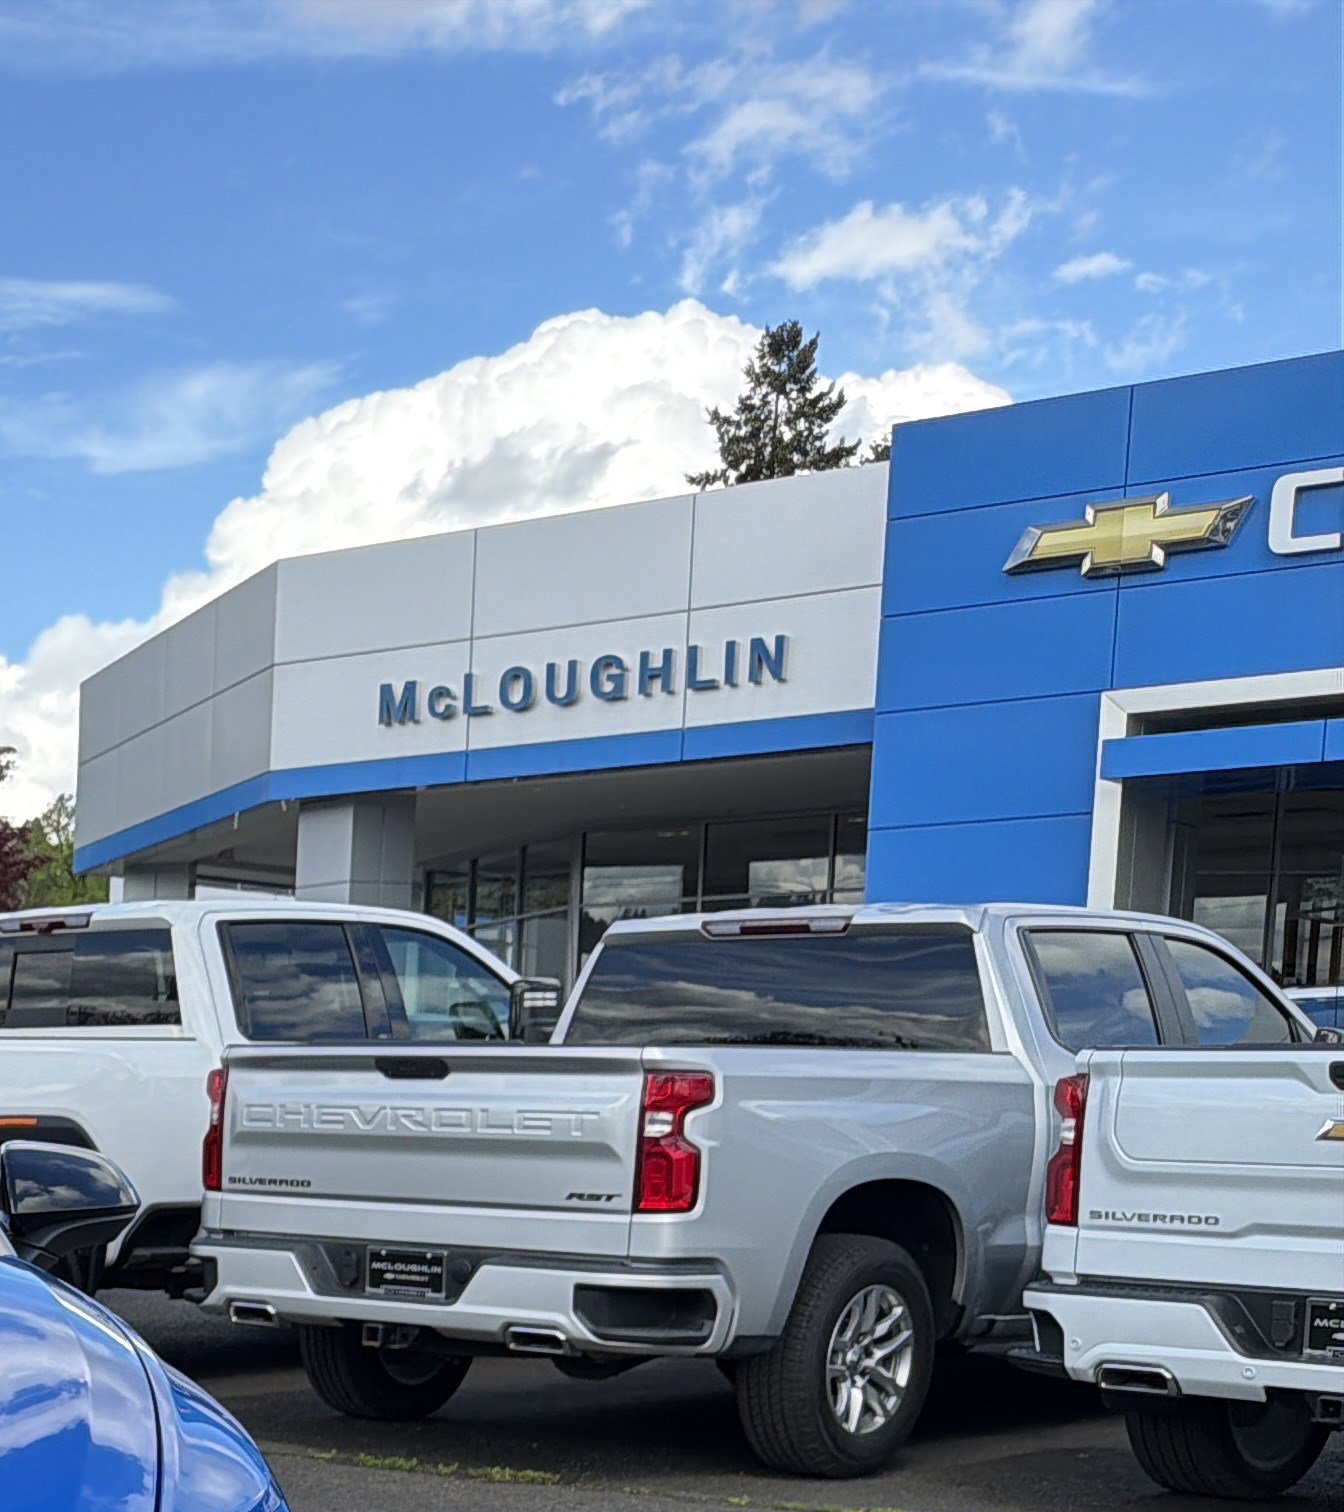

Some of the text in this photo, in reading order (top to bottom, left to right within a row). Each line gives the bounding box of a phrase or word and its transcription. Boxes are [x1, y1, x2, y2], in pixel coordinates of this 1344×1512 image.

[378, 634, 787, 726] McLOUGHLIN
[242, 1103, 601, 1138] CHEVROLET
[228, 1176, 312, 1188] SILVERADO
[1089, 1210, 1219, 1226] SILVERADO
